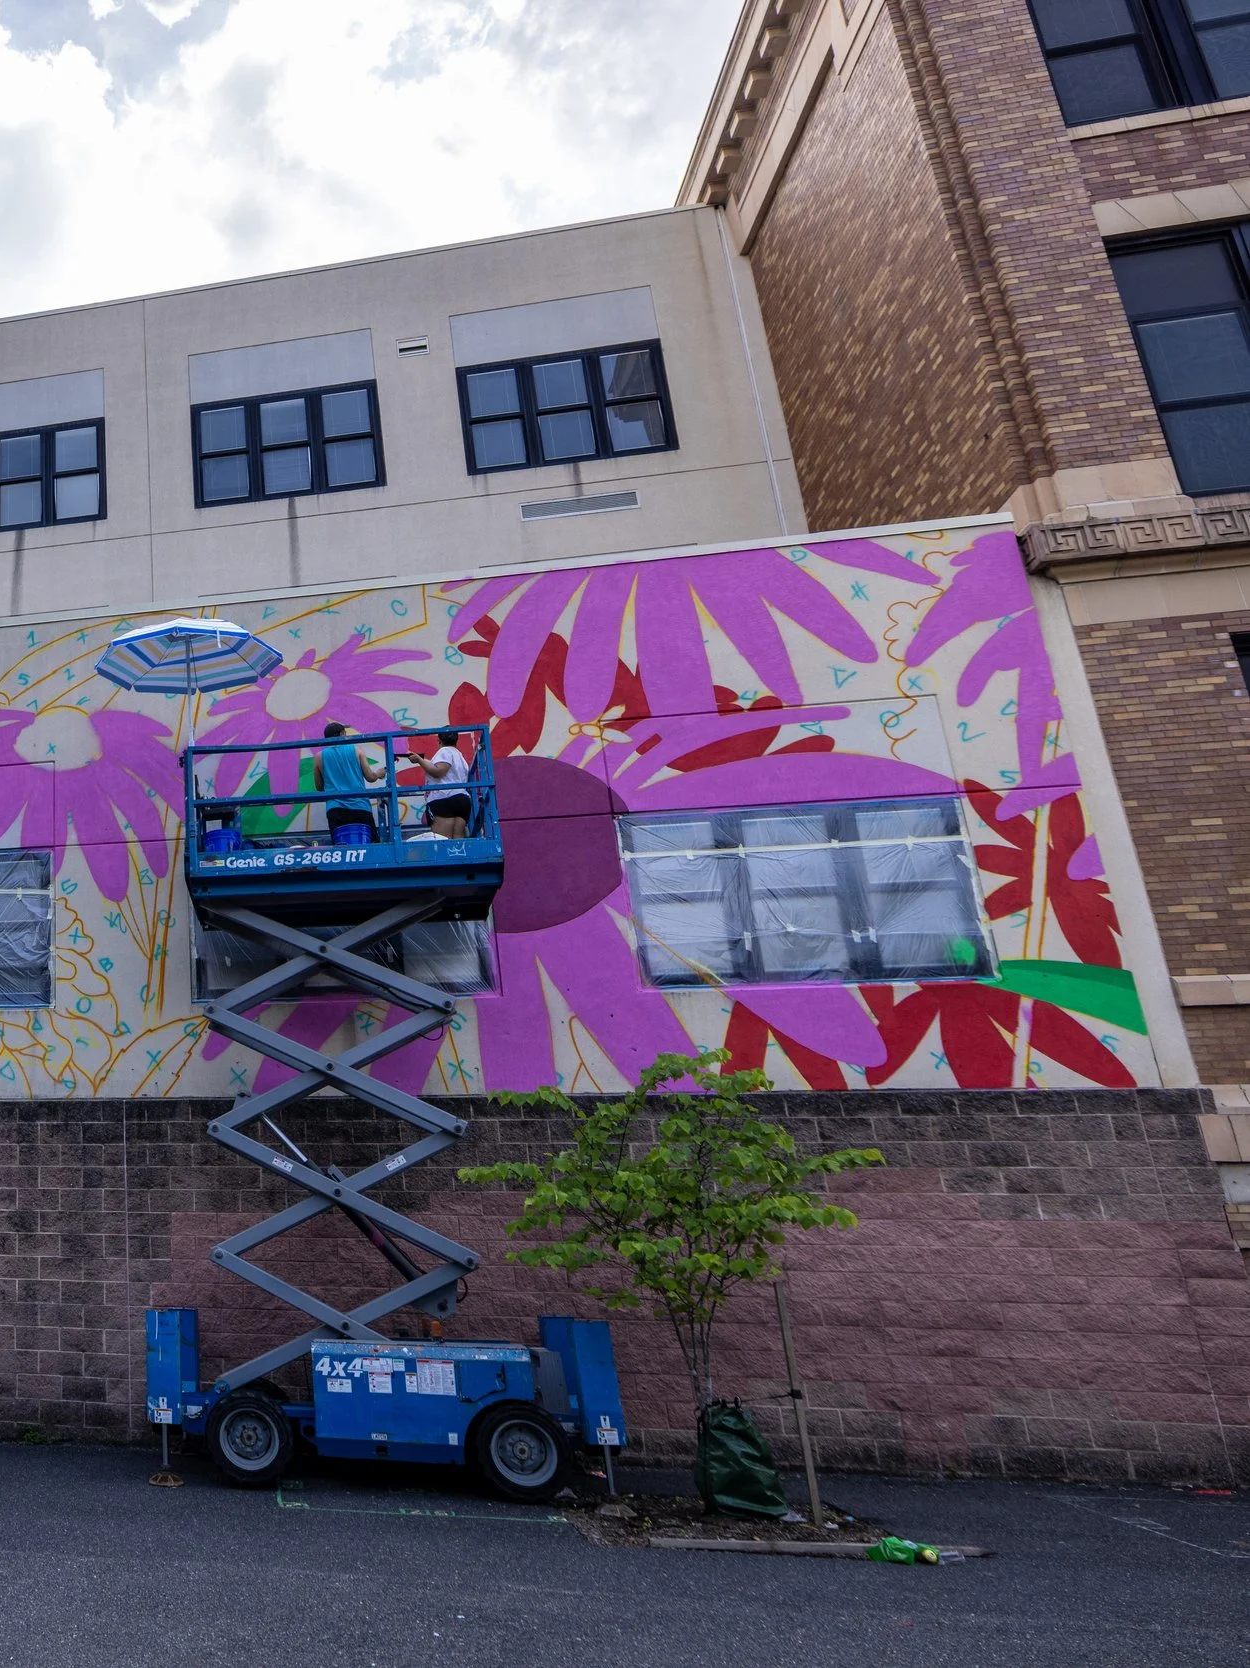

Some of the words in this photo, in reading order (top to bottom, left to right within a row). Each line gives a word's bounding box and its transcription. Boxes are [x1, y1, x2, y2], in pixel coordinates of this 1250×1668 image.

[18, 673, 30, 686] 5
[226, 856, 266, 868] Genie
[274, 851, 342, 866] GS-2668
[345, 849, 367, 862] RT
[315, 1356, 364, 1378] 4x4
